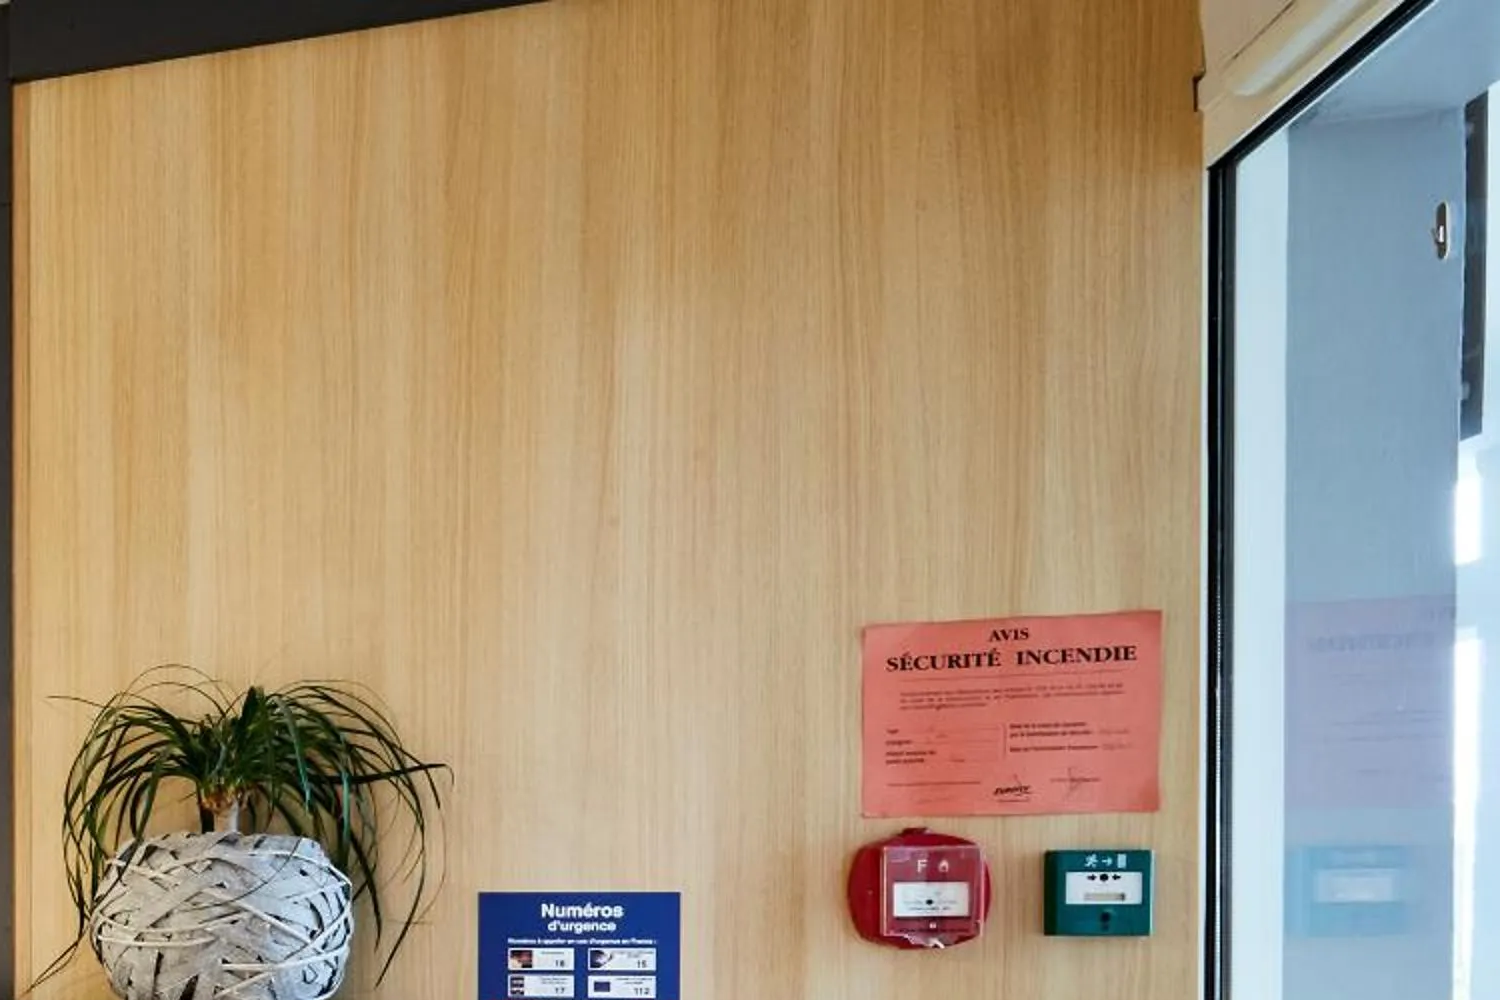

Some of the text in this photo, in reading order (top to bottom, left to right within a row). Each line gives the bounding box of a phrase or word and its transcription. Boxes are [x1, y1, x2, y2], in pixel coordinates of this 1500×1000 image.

[989, 627, 1029, 642] AVIS
[885, 645, 1137, 672] SÉCURITÉ INCENDIE
[541, 902, 625, 919] Numéros
[547, 920, 617, 935] d'urgence
